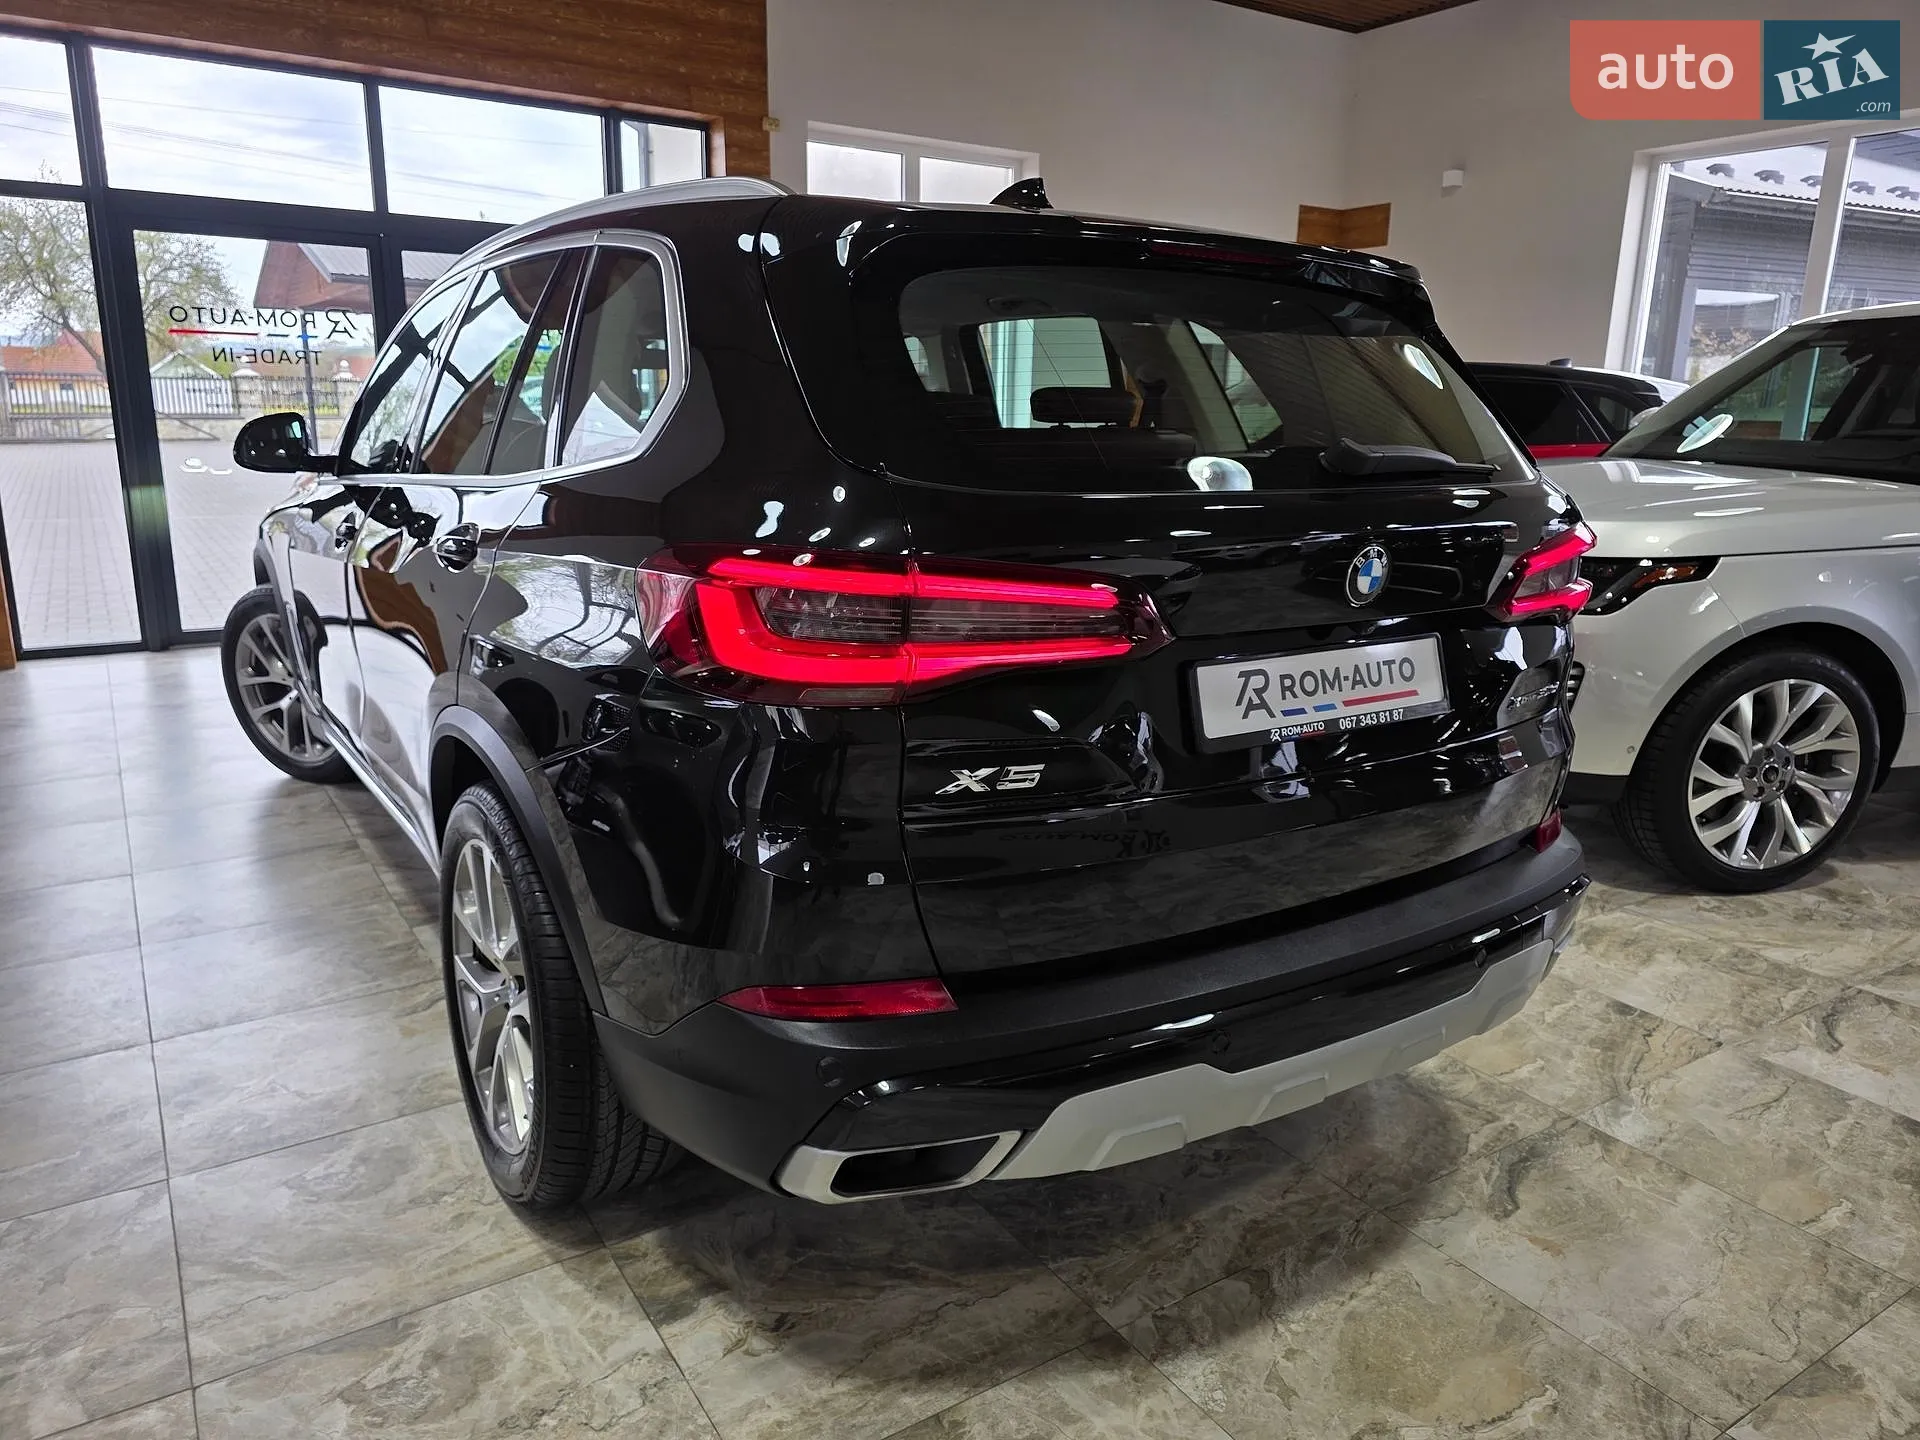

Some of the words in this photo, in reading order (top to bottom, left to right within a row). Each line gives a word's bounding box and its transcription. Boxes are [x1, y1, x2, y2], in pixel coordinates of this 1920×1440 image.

[1279, 656, 1416, 701] ROM-AUTO
[1281, 722, 1325, 737] ROM-AUTO
[1339, 716, 1357, 730] 067
[1359, 713, 1378, 727] 343
[1379, 711, 1391, 724] 81
[1393, 709, 1404, 721] 87
[934, 763, 1046, 795] X5
